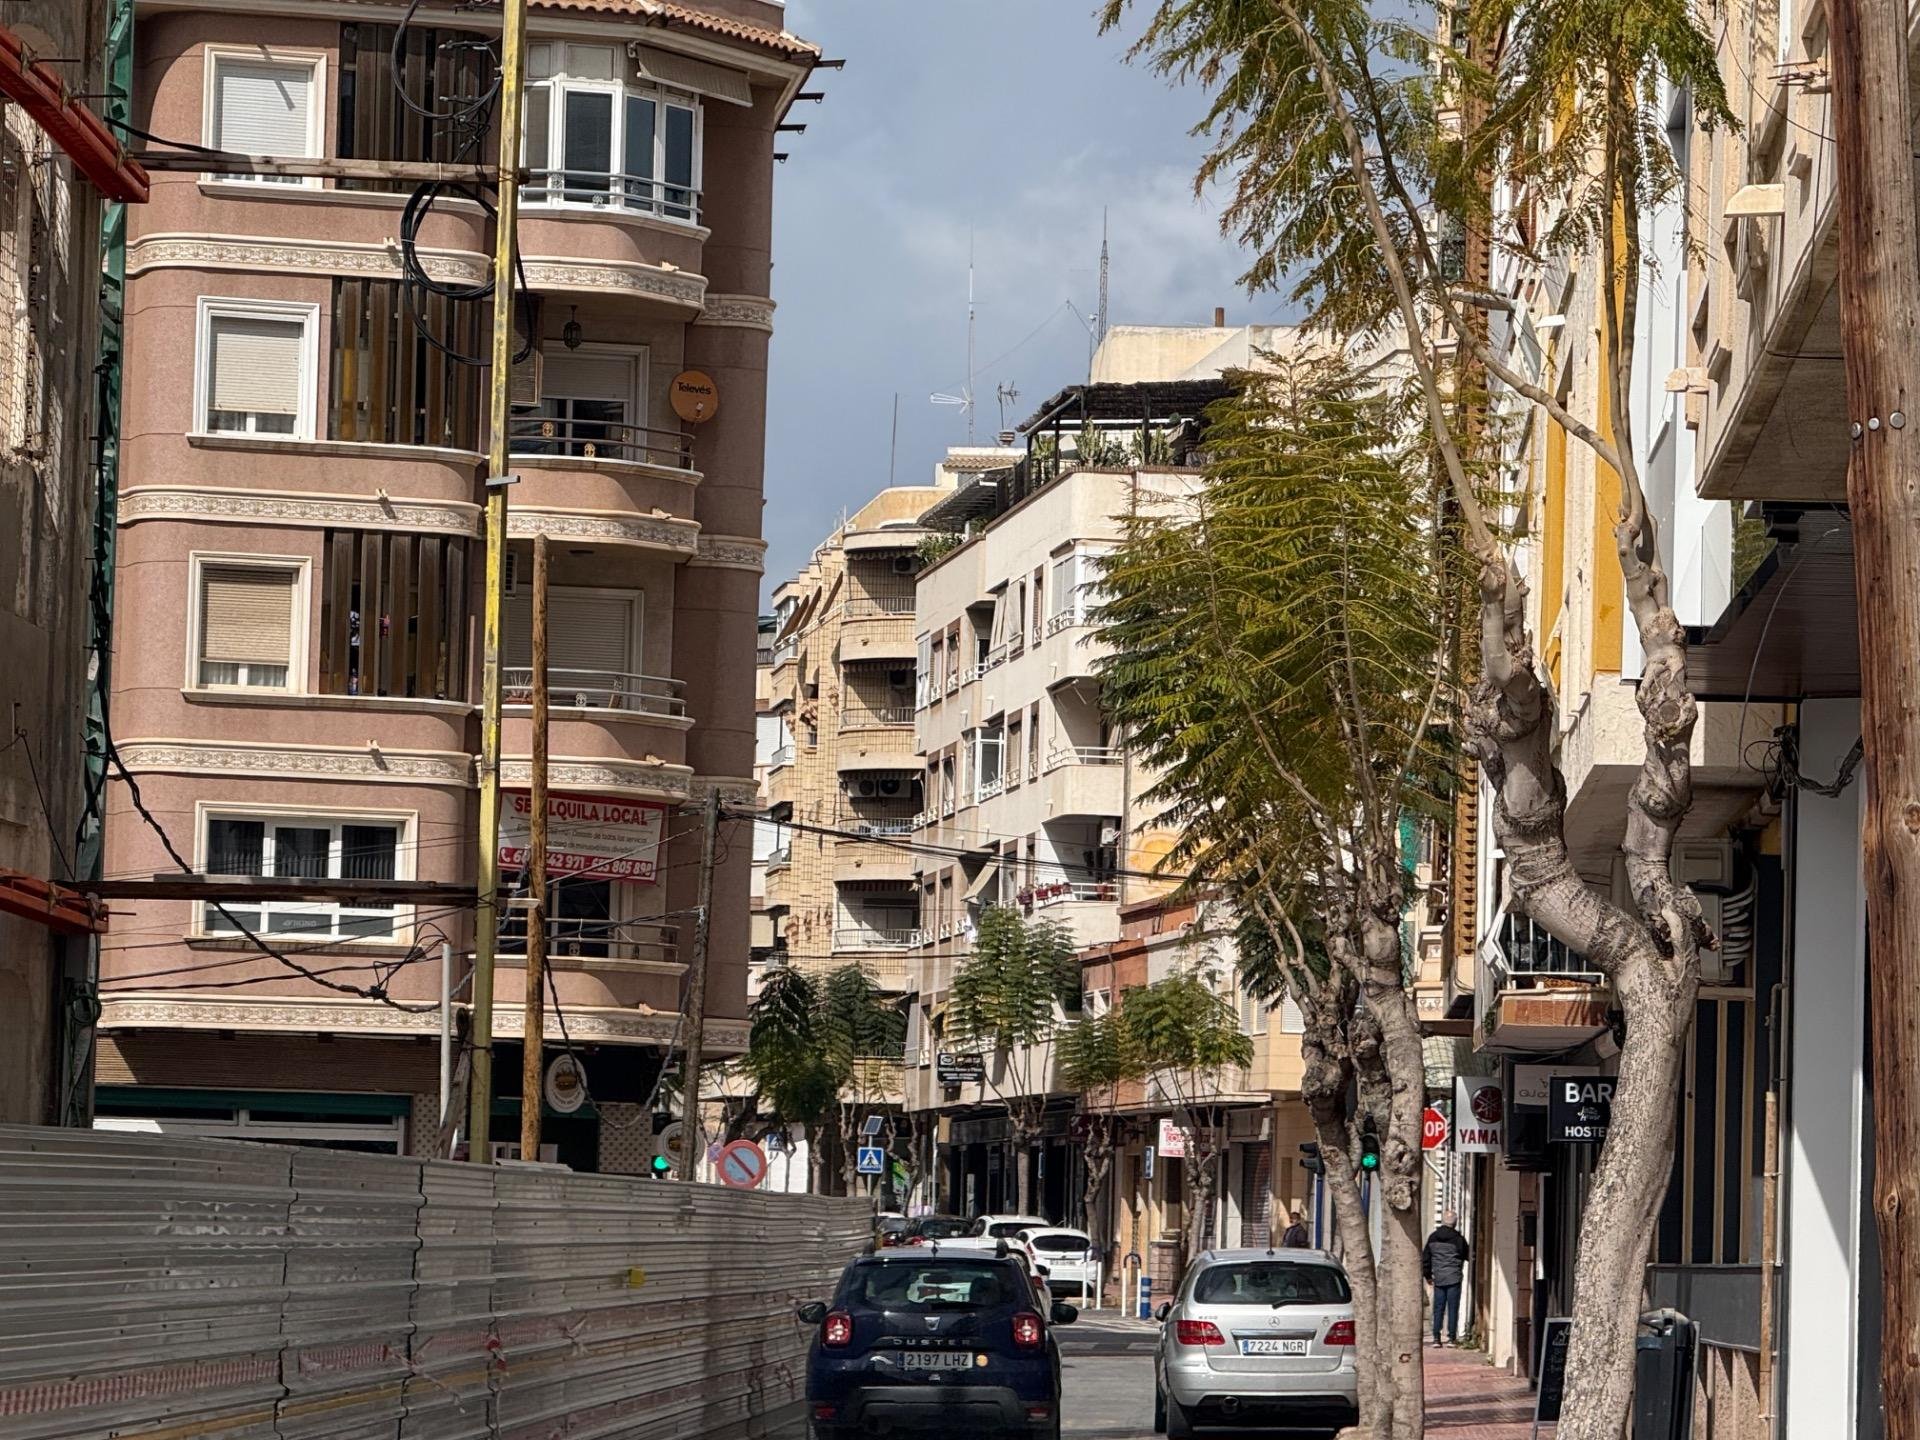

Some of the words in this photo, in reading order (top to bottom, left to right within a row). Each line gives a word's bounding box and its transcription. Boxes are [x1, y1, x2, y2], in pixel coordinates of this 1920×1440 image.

[514, 796, 531, 813] SE
[548, 800, 600, 821] LQUILA
[603, 805, 648, 826] LOCAL
[565, 854, 585, 870] 971
[611, 860, 633, 875] 805
[1565, 1082, 1612, 1103] BAR
[1424, 1121, 1444, 1137] OP
[1459, 1128, 1502, 1145] YAMA
[1564, 1126, 1606, 1138] HOSTE
[893, 1338, 971, 1346] DUSTER
[1250, 1340, 1279, 1352] 7224
[1282, 1340, 1304, 1352] NGR
[906, 1353, 940, 1366] 2197
[943, 1353, 969, 1367] LHZ
